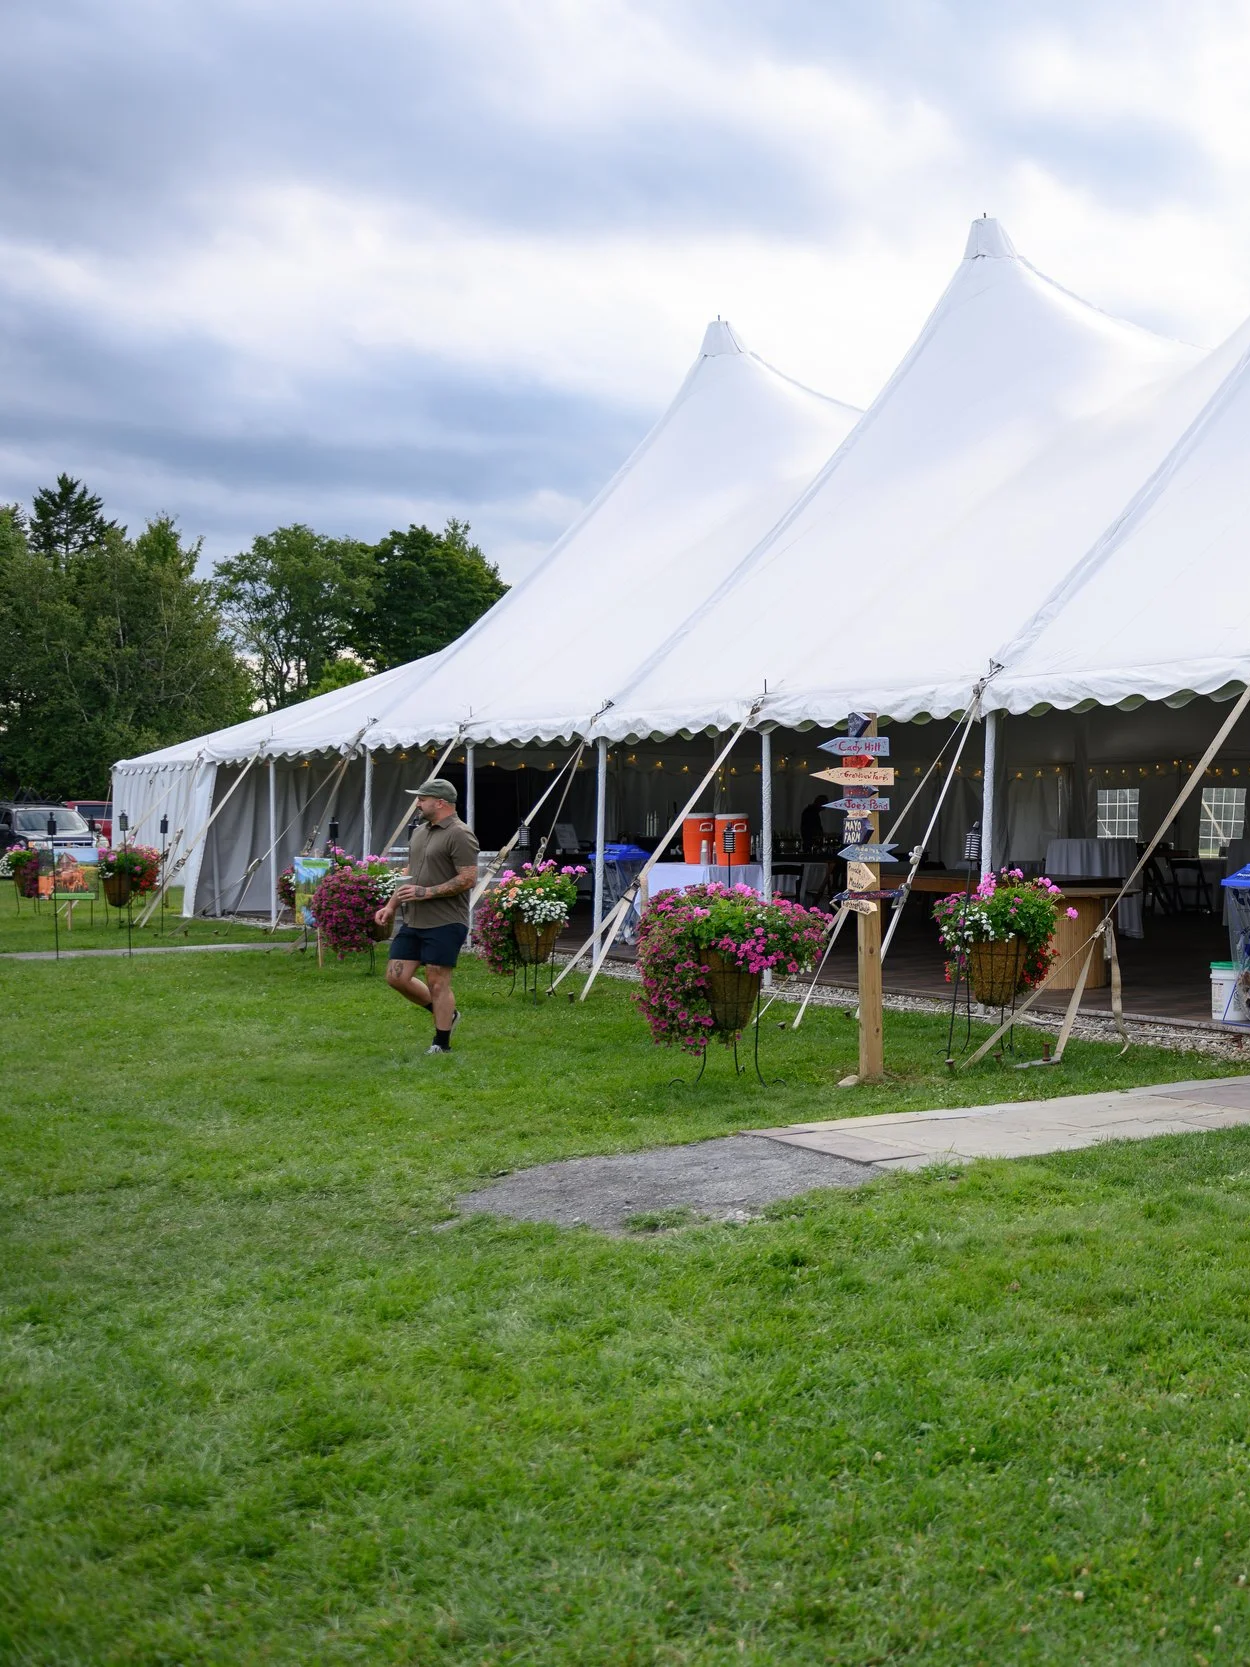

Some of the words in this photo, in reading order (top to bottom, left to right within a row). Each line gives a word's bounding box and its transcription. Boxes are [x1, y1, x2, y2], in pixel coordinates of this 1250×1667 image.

[838, 740, 862, 754] Cady
[864, 742, 881, 752] Hill
[869, 799, 888, 810] Pond
[844, 820, 862, 831] MAYO
[843, 832, 861, 844] FARM
